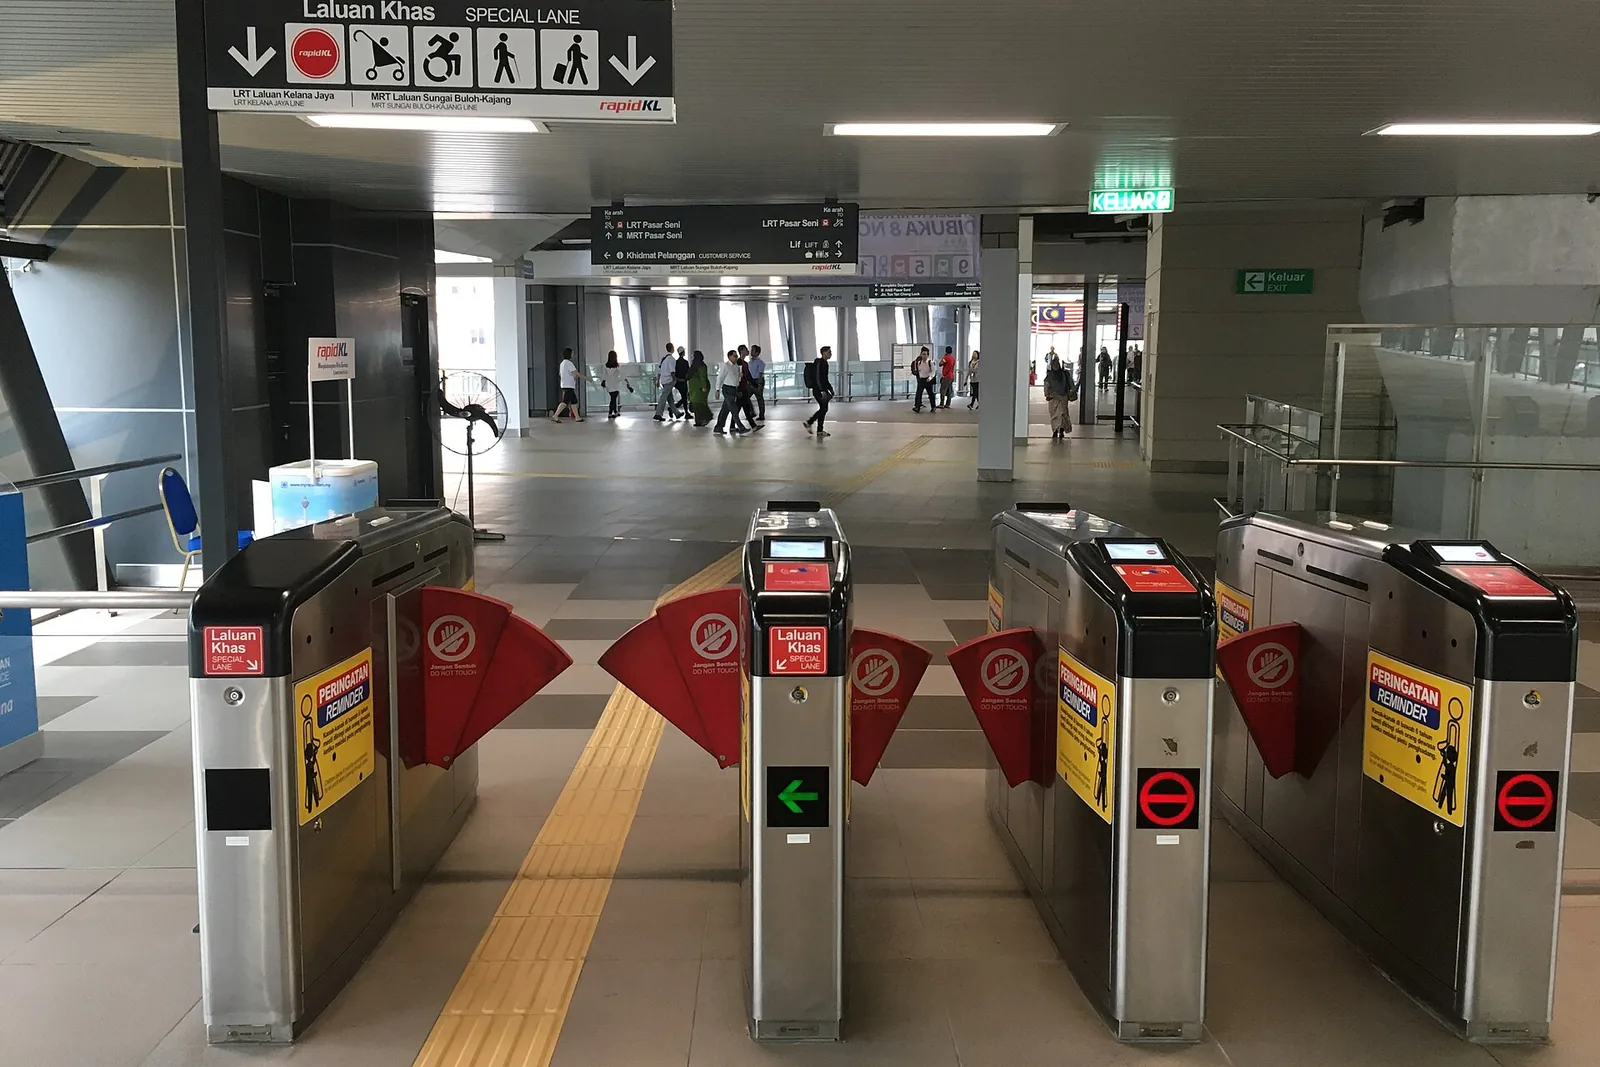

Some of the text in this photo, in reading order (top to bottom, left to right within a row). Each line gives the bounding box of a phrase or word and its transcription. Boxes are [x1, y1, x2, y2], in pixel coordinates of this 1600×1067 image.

[303, 0, 436, 21] Laluan Khas
[465, 7, 580, 25] SPECIAL LANE
[299, 50, 332, 58] rapidKL
[233, 89, 335, 101] LRT Laluan Kelana Jaya
[371, 92, 512, 105] MRT Laluan Sungai Buloh-Kajang
[246, 99, 273, 107] KELANA
[413, 103, 462, 111] BULOH-KAJANG
[600, 100, 662, 113] rapidKL
[1092, 192, 1157, 211] KELUAR
[642, 221, 664, 229] Pasar
[664, 220, 681, 228] Seni
[780, 220, 801, 228] Pasar
[644, 232, 666, 240] Pasar
[790, 241, 801, 249] Lif
[626, 252, 656, 260] Khidmat
[658, 252, 696, 260] Pelanggan
[1267, 272, 1306, 292] Keluar EXIT
[317, 343, 348, 360] rapidKL
[1222, 594, 1249, 621] PERINGATAN
[1222, 609, 1244, 632] REMINDER
[211, 630, 256, 641] Laluan
[777, 629, 821, 641] Laluan
[211, 642, 246, 654] Khas
[788, 642, 821, 654] Khas
[319, 663, 369, 704] PERINGATAN
[1060, 664, 1096, 704] PERINGATAN
[1372, 666, 1439, 706] PERINGATAN
[326, 686, 364, 722] REMINDER
[1062, 686, 1091, 720] REMINDER
[1377, 688, 1428, 723] REMINDER
